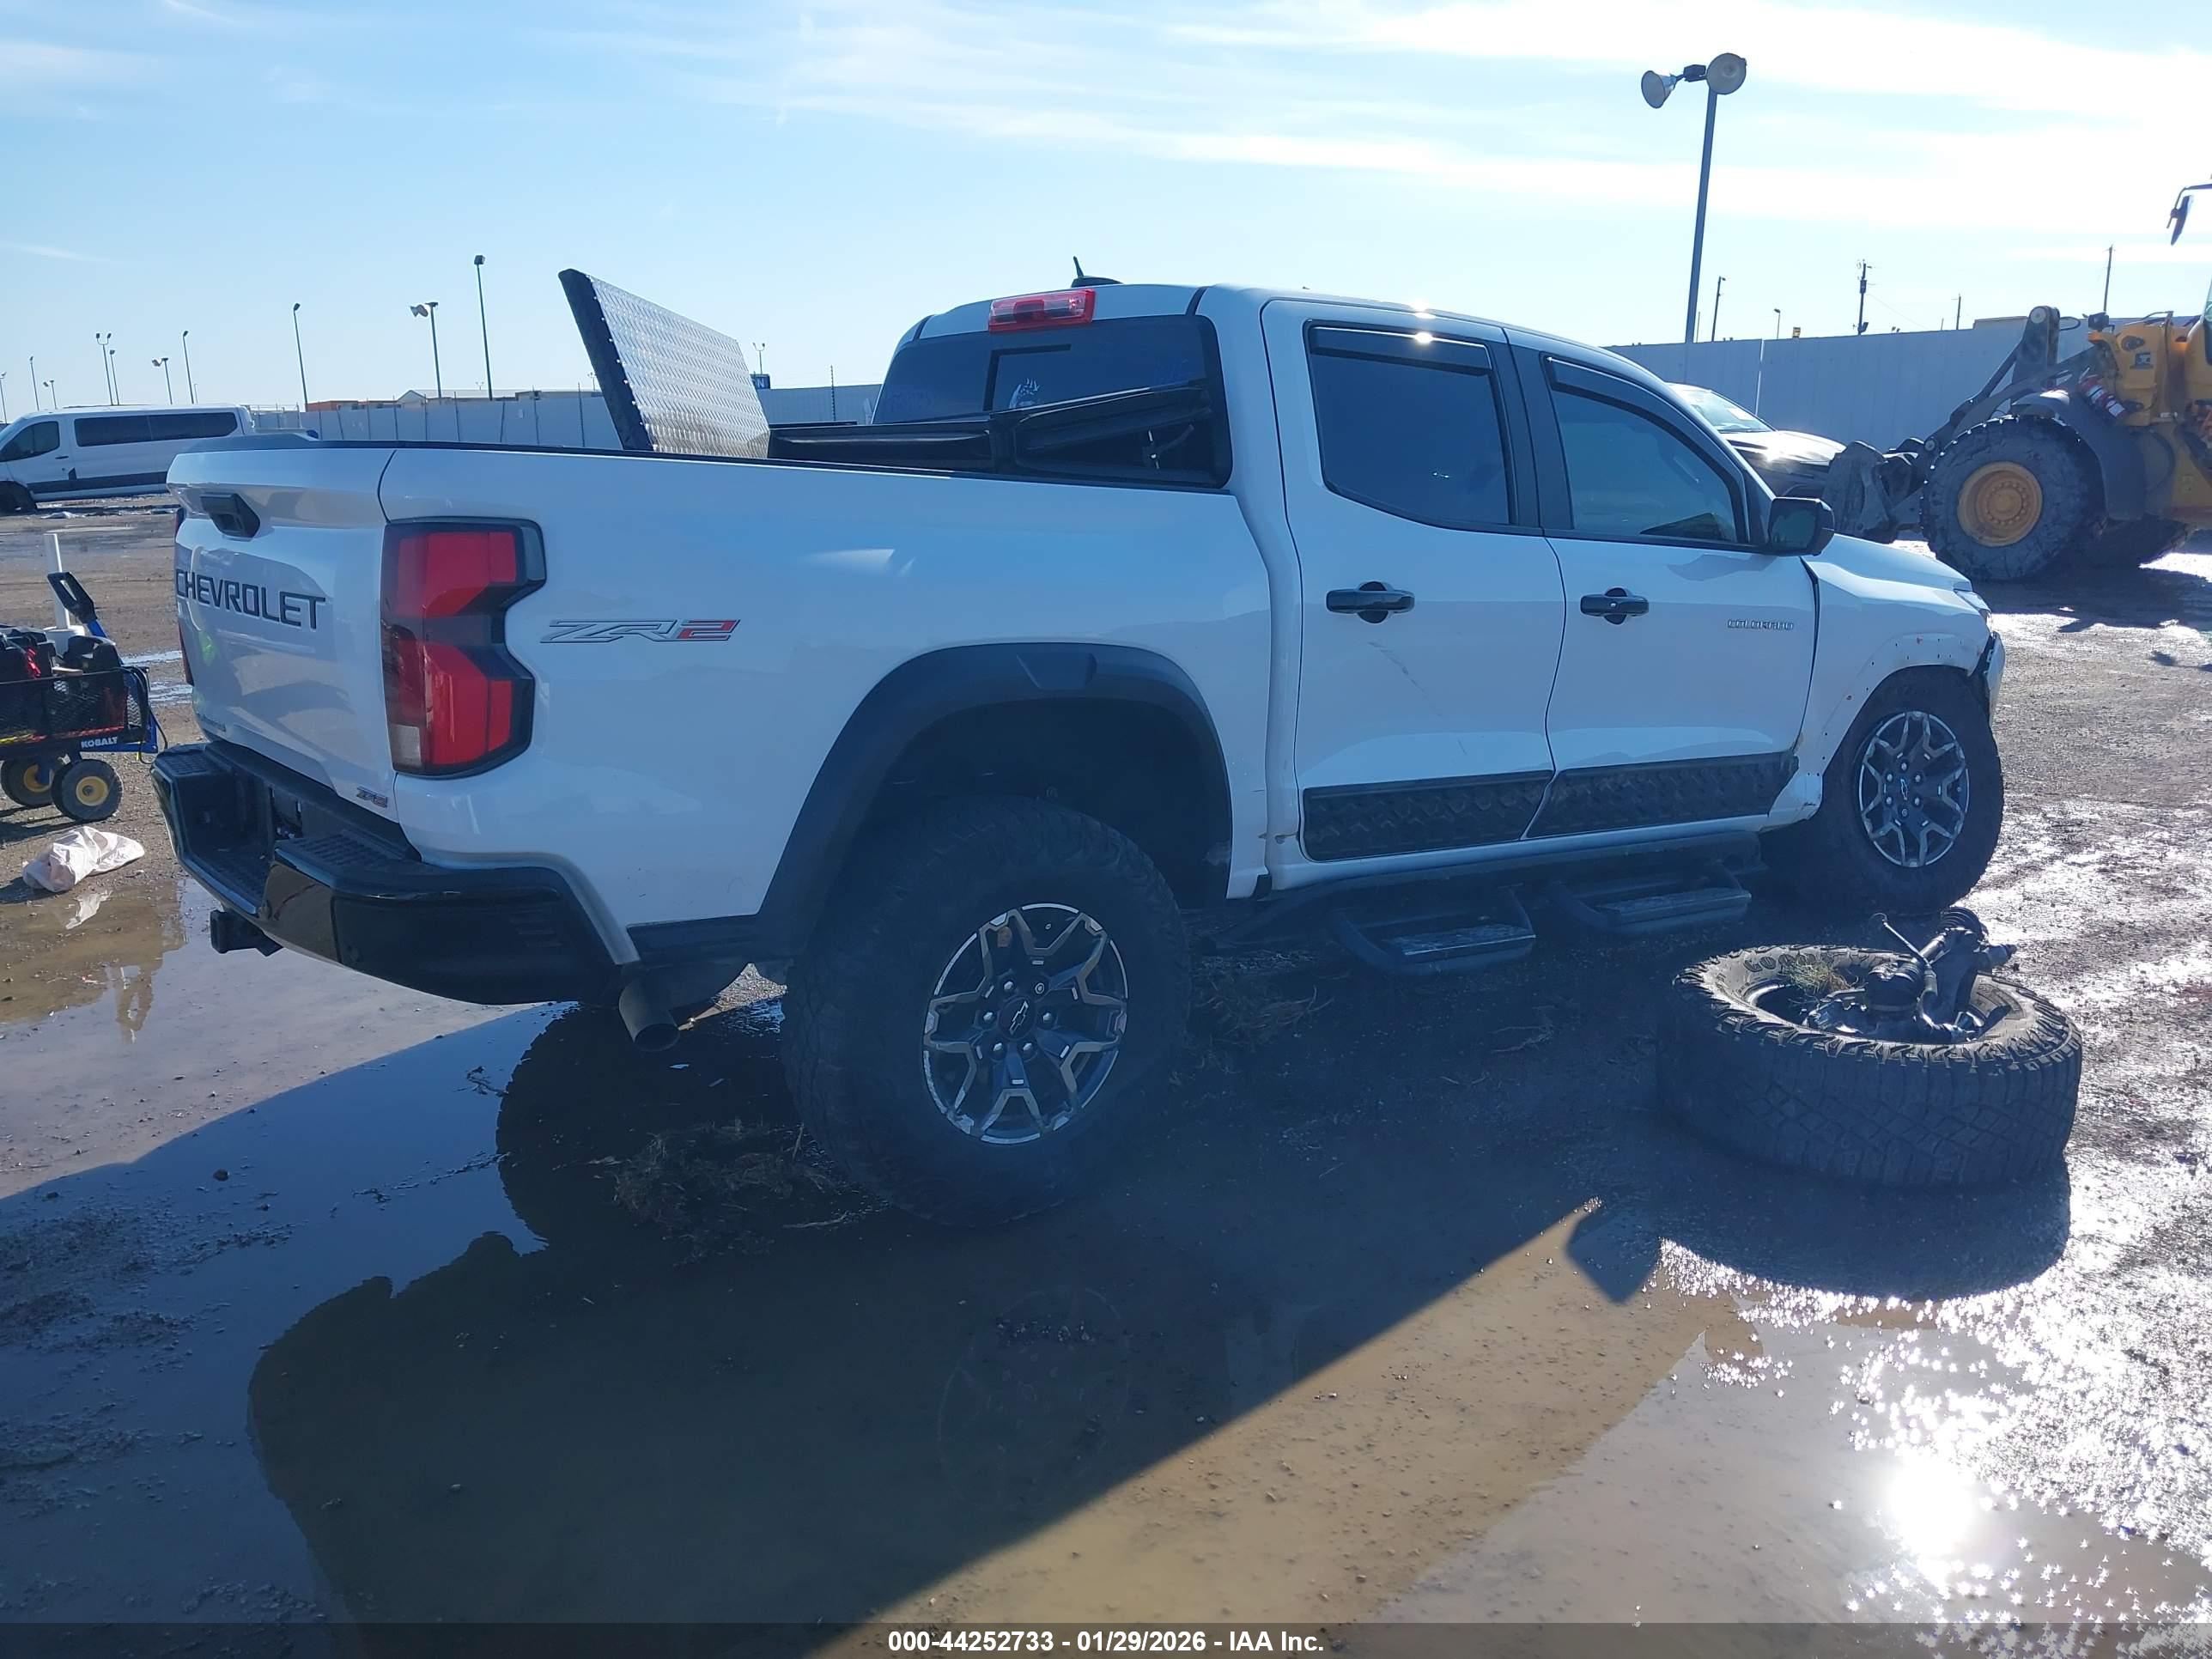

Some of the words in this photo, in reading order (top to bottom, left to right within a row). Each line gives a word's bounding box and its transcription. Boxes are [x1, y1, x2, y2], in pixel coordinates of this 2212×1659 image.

[176, 568, 326, 629] CHEVROLET
[540, 619, 740, 643] ZR2
[81, 737, 118, 748] KOBALT
